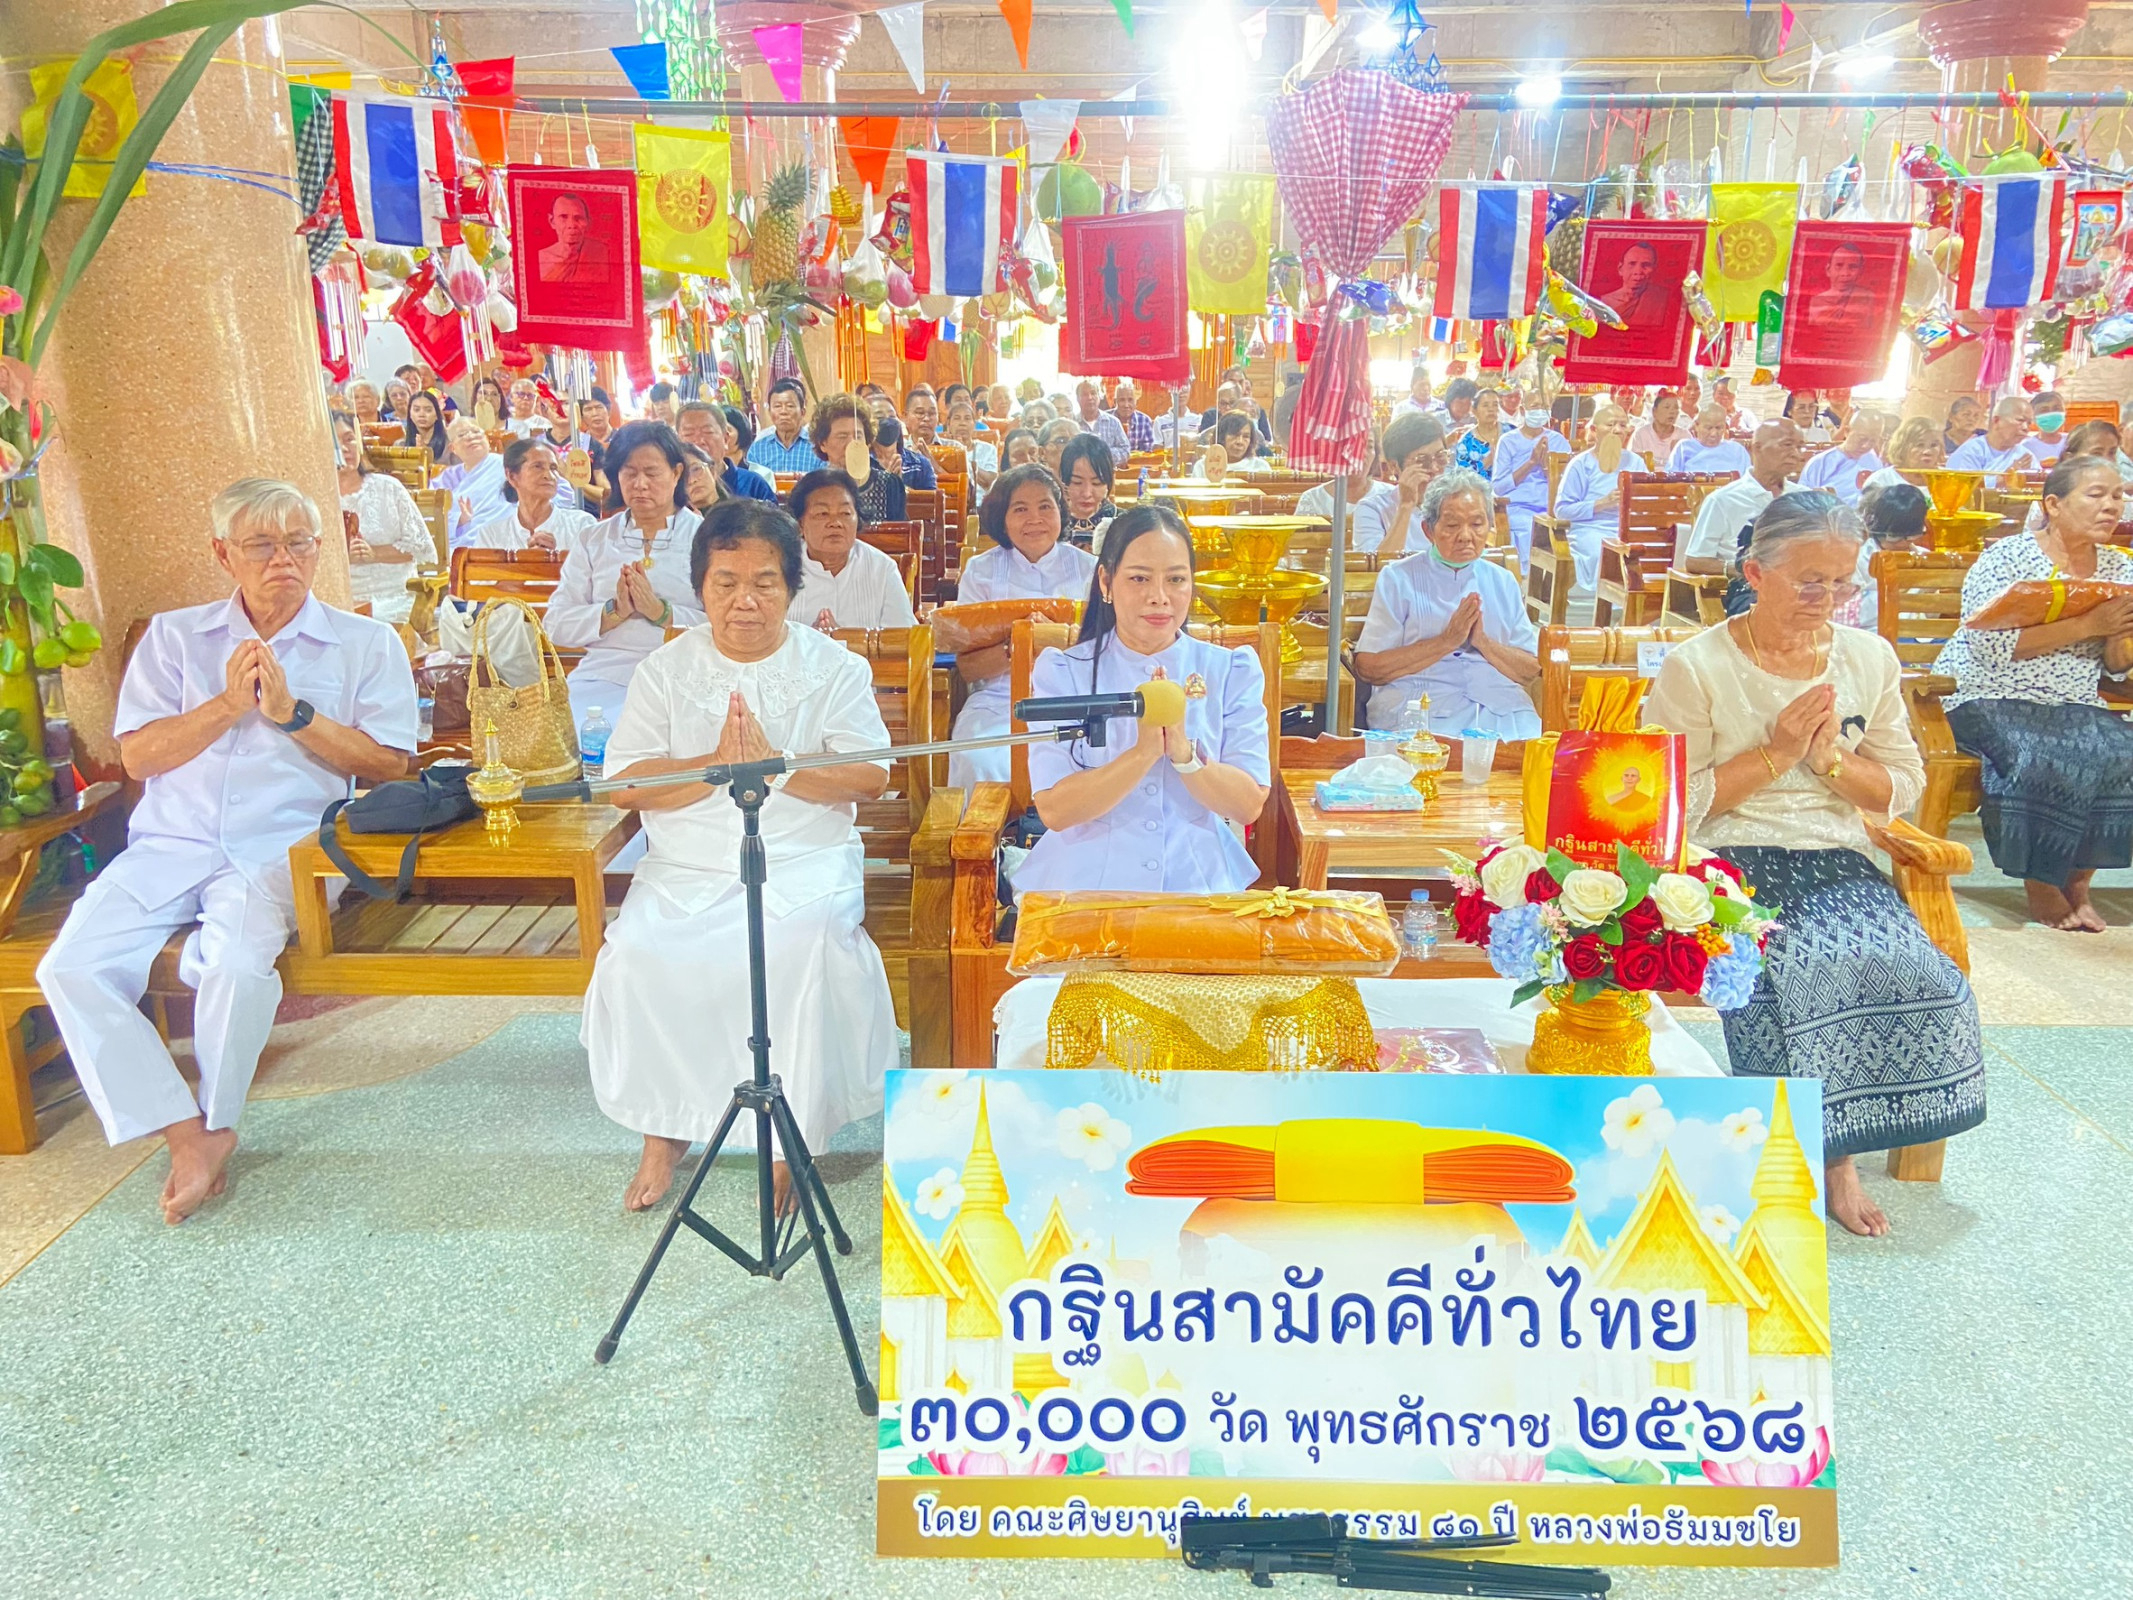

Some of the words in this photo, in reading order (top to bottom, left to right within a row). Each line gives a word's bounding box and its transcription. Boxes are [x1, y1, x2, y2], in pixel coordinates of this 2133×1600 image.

[1009, 1245, 1696, 1366] กฐินสามัคคีทั่วไทย
[911, 1397, 1187, 1454] ๓๐,๐๐๐
[1209, 1391, 1268, 1443] วัด
[1285, 1394, 1550, 1464] พุทธศักราช
[1573, 1396, 1806, 1455] ๒๕๖๘
[918, 1500, 977, 1531] โดย
[1433, 1515, 1479, 1540] ๘๑
[1493, 1505, 1514, 1537] ปี
[1530, 1507, 1797, 1543] หลวงพ่อธัมมชโย
